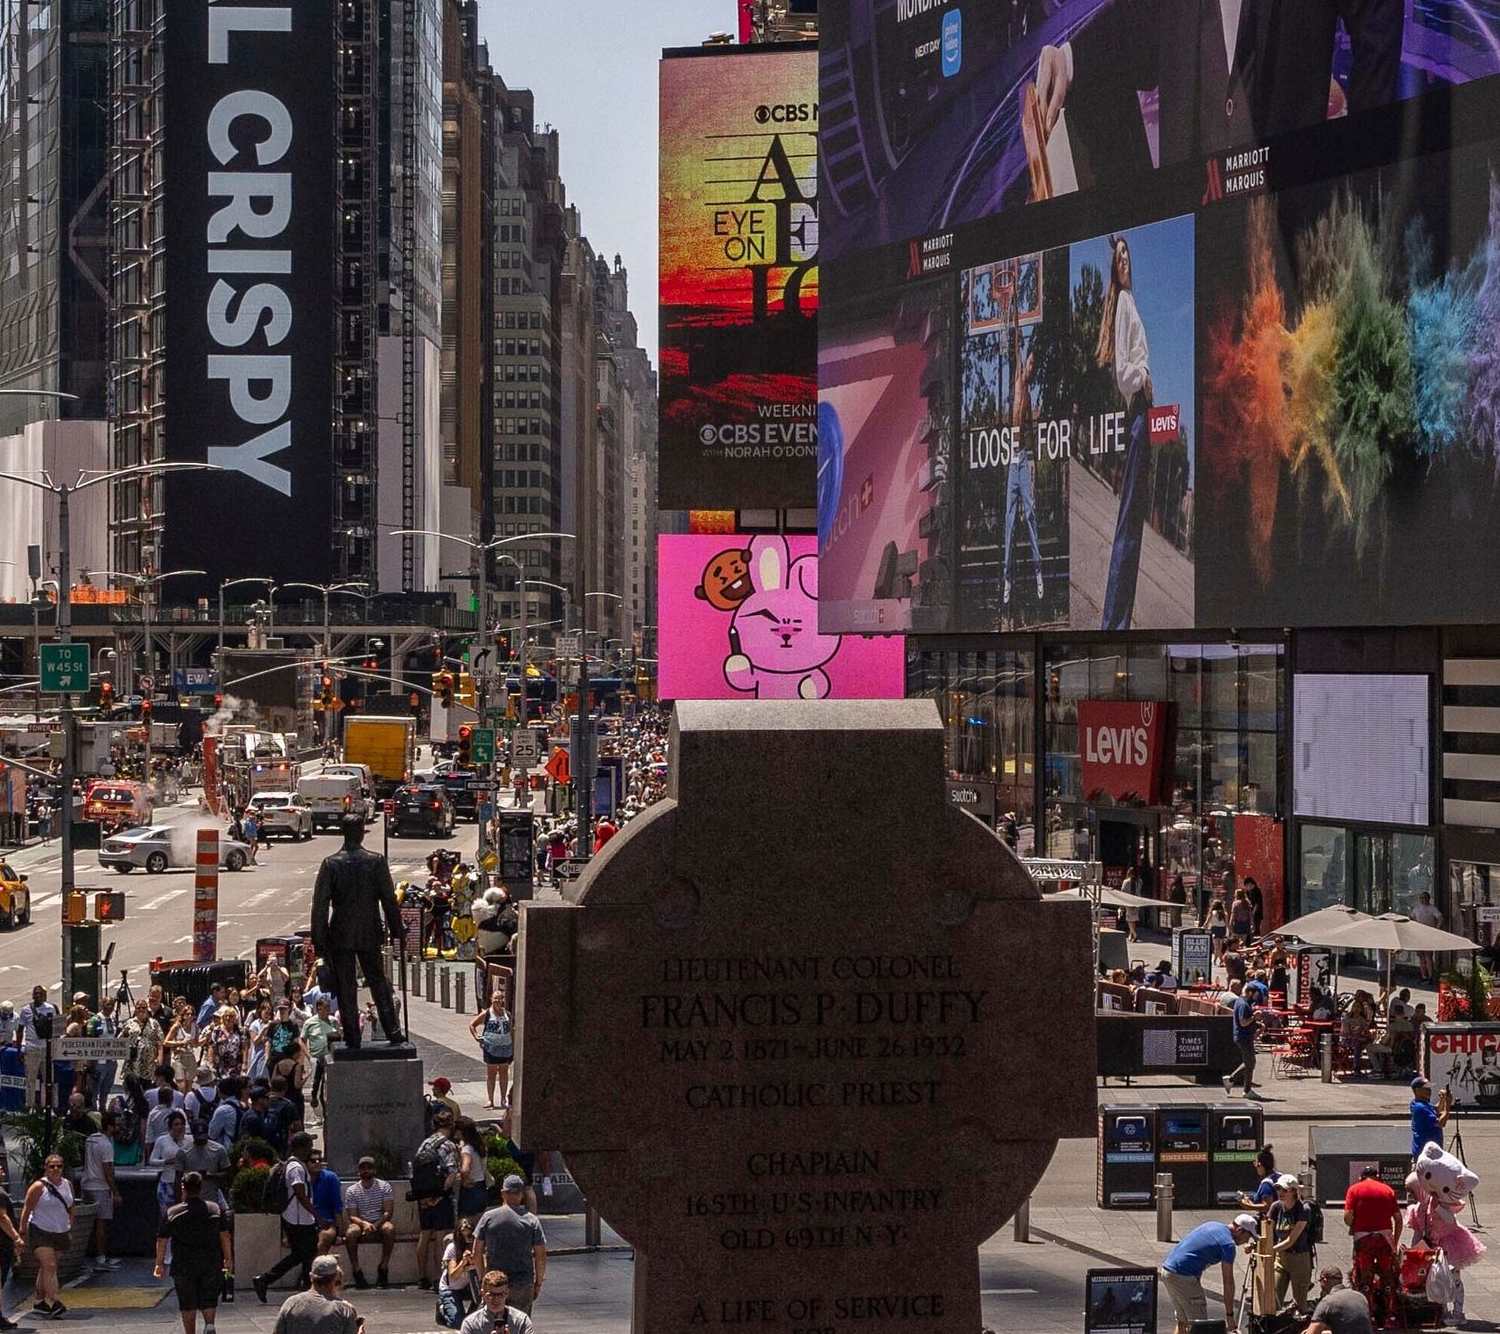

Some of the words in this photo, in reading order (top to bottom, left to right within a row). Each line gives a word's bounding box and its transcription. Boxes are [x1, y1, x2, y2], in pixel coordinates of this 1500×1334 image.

[771, 104, 808, 122] CBS
[1225, 146, 1270, 172] MARRIOTT
[1225, 169, 1266, 193] MARQUIS
[714, 210, 765, 235] EYE
[725, 238, 765, 260] ON
[923, 234, 953, 252] MARRIOTT
[923, 253, 950, 269] MARQUIS
[206, 89, 292, 497] CRISPY
[969, 426, 1020, 468] LOOSE
[1037, 419, 1071, 460] FOR
[1089, 411, 1125, 455] LIFE
[58, 650, 71, 658] TO
[47, 662, 58, 672] W
[59, 662, 71, 672] 45
[73, 662, 83, 672] St
[473, 668, 492, 676] ONLY
[516, 745, 534, 756] 25
[562, 864, 579, 872] ONE
[1186, 938, 1207, 946] BLUE
[1179, 1044, 1204, 1052] SQUARE
[746, 1151, 881, 1178] CHAPLAIN
